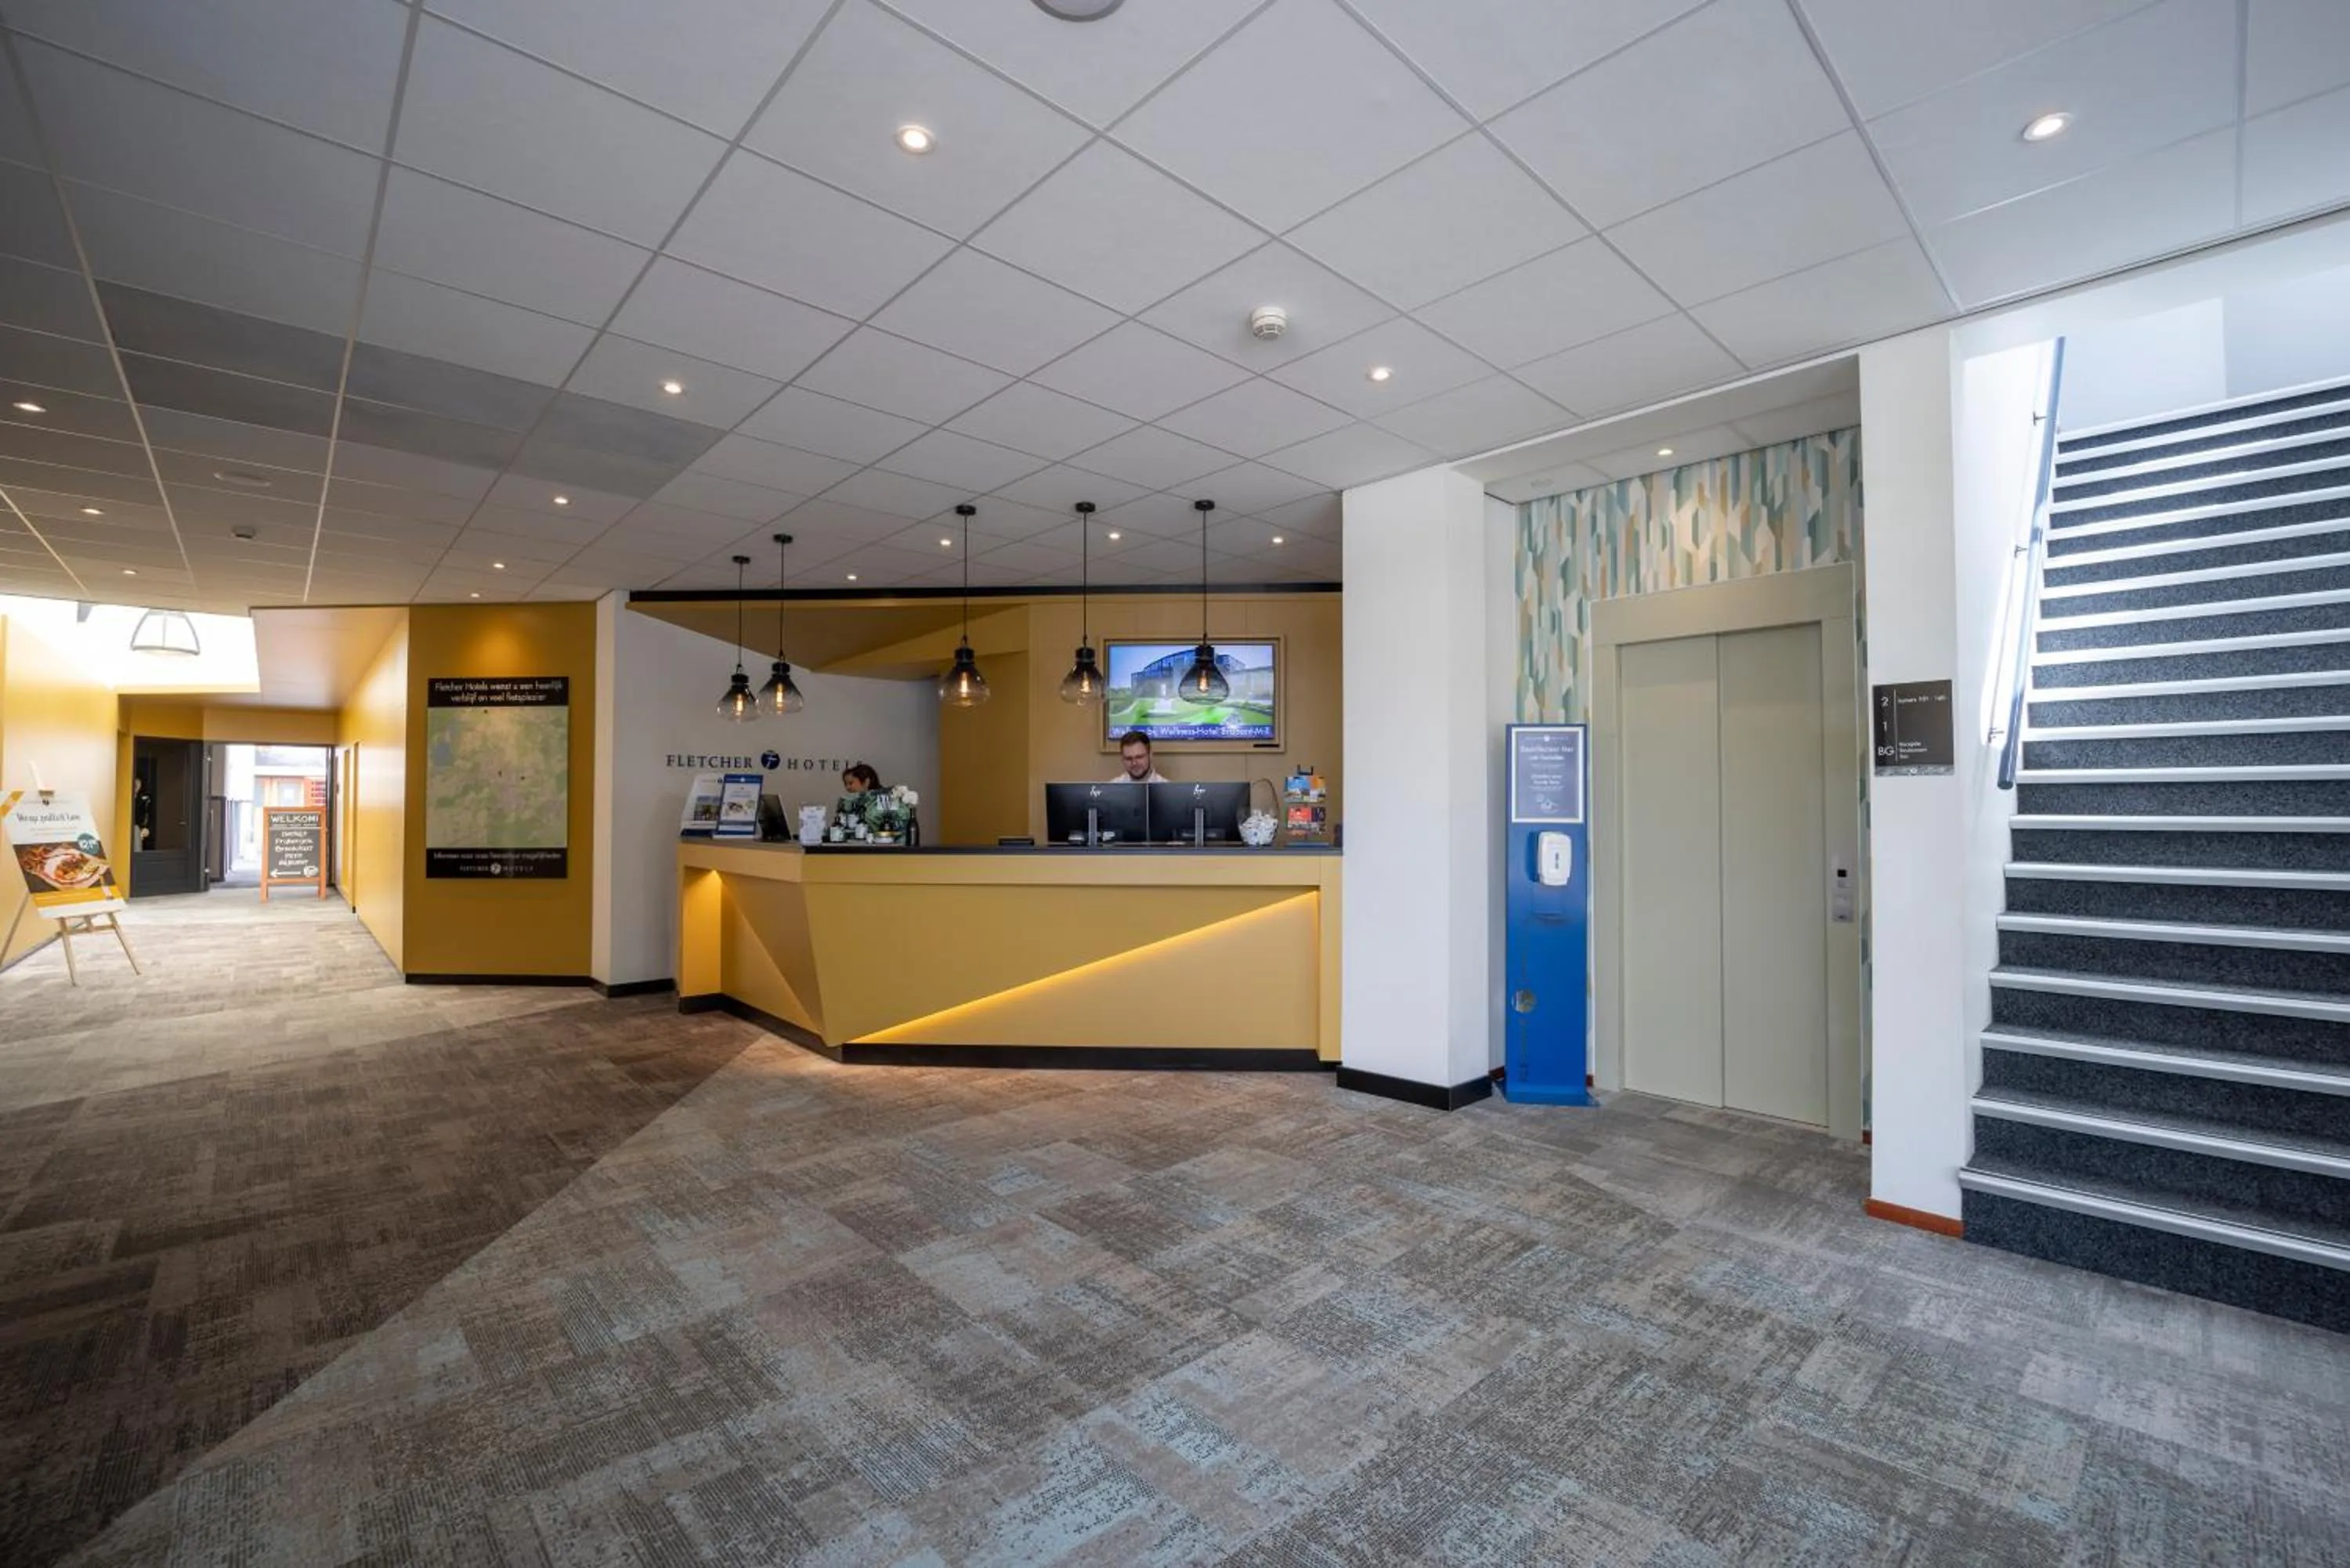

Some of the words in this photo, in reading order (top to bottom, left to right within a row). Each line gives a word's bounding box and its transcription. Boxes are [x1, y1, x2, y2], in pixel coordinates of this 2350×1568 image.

[435, 681, 463, 691] Fletcher
[465, 681, 488, 690] Hotels
[1881, 696, 1889, 707] 2
[1883, 721, 1888, 732] 1
[1878, 746, 1895, 757] BG
[667, 754, 753, 769] FLETCHER
